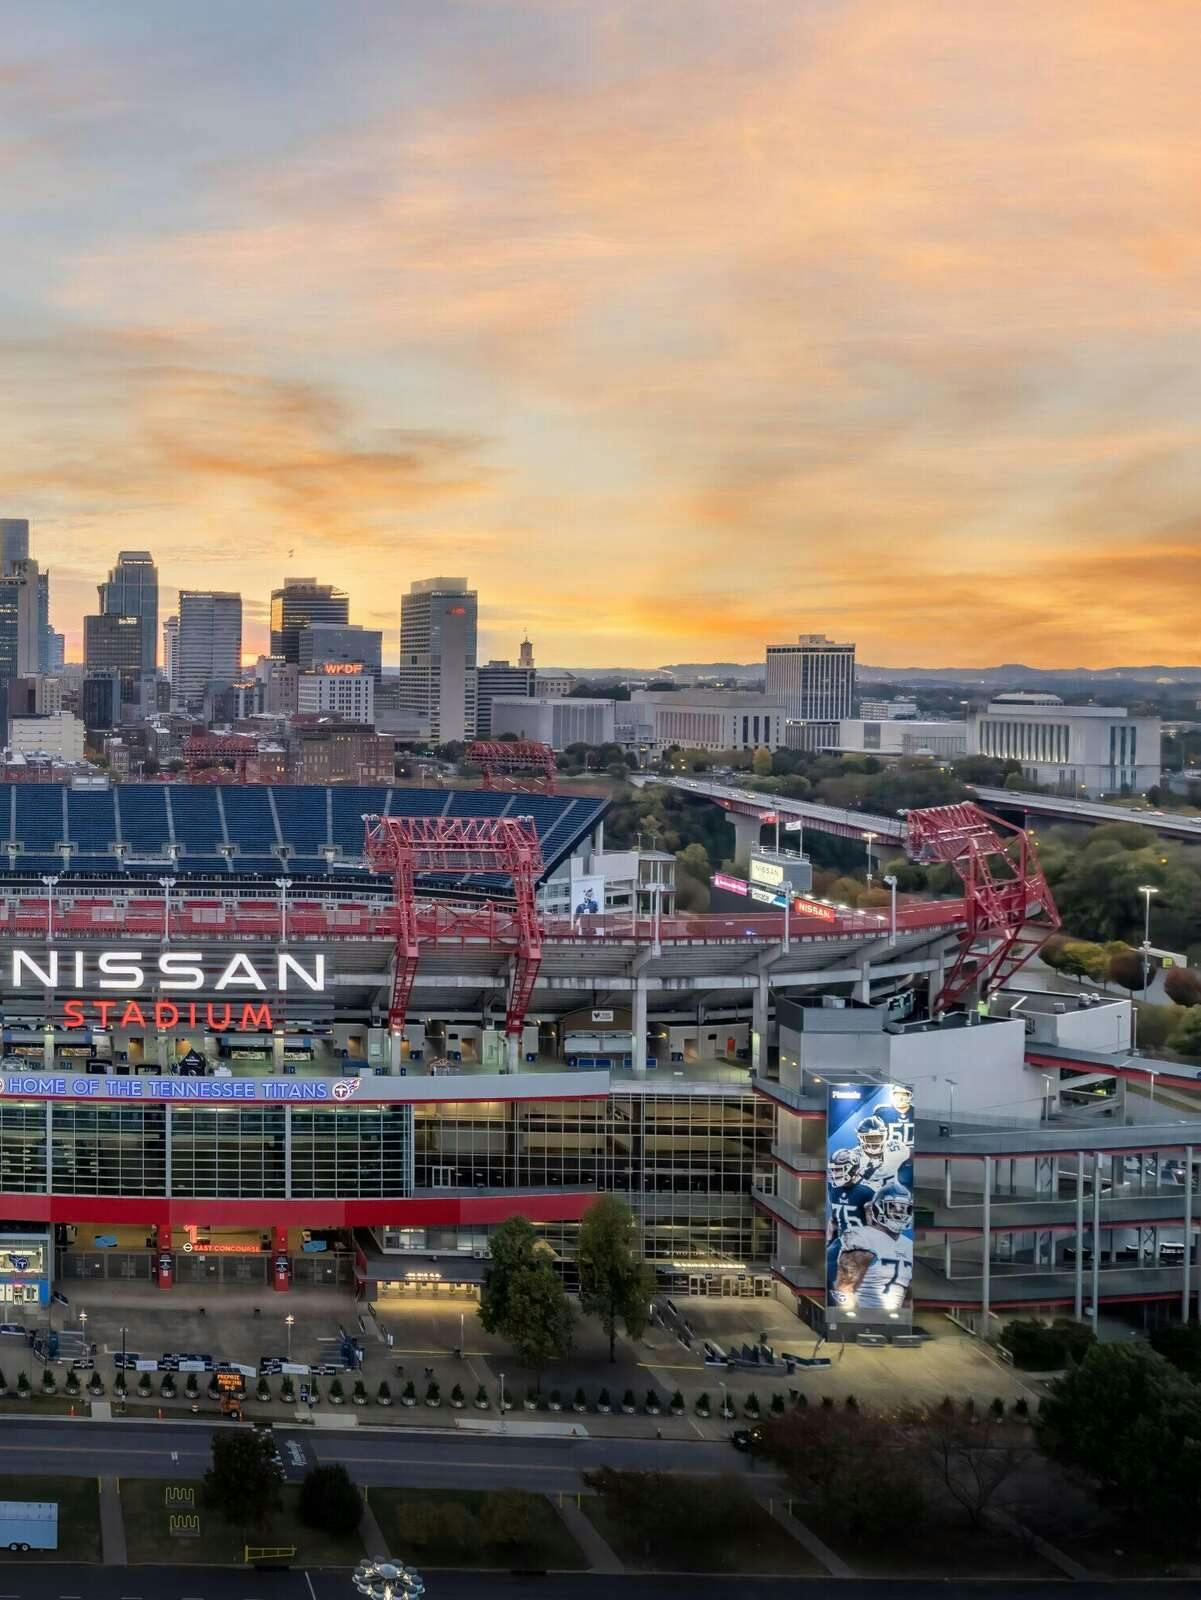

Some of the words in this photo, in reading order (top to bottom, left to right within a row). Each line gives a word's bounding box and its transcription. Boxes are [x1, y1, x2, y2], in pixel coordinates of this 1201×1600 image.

[799, 904, 831, 918] NISSAN
[12, 950, 325, 991] NISSAN
[63, 1001, 274, 1030] STADIUM
[8, 1077, 66, 1094] HOME
[73, 1079, 100, 1095] OF
[105, 1081, 143, 1096] THE
[149, 1081, 256, 1097] TENNESSEE
[262, 1083, 328, 1098] TITANS
